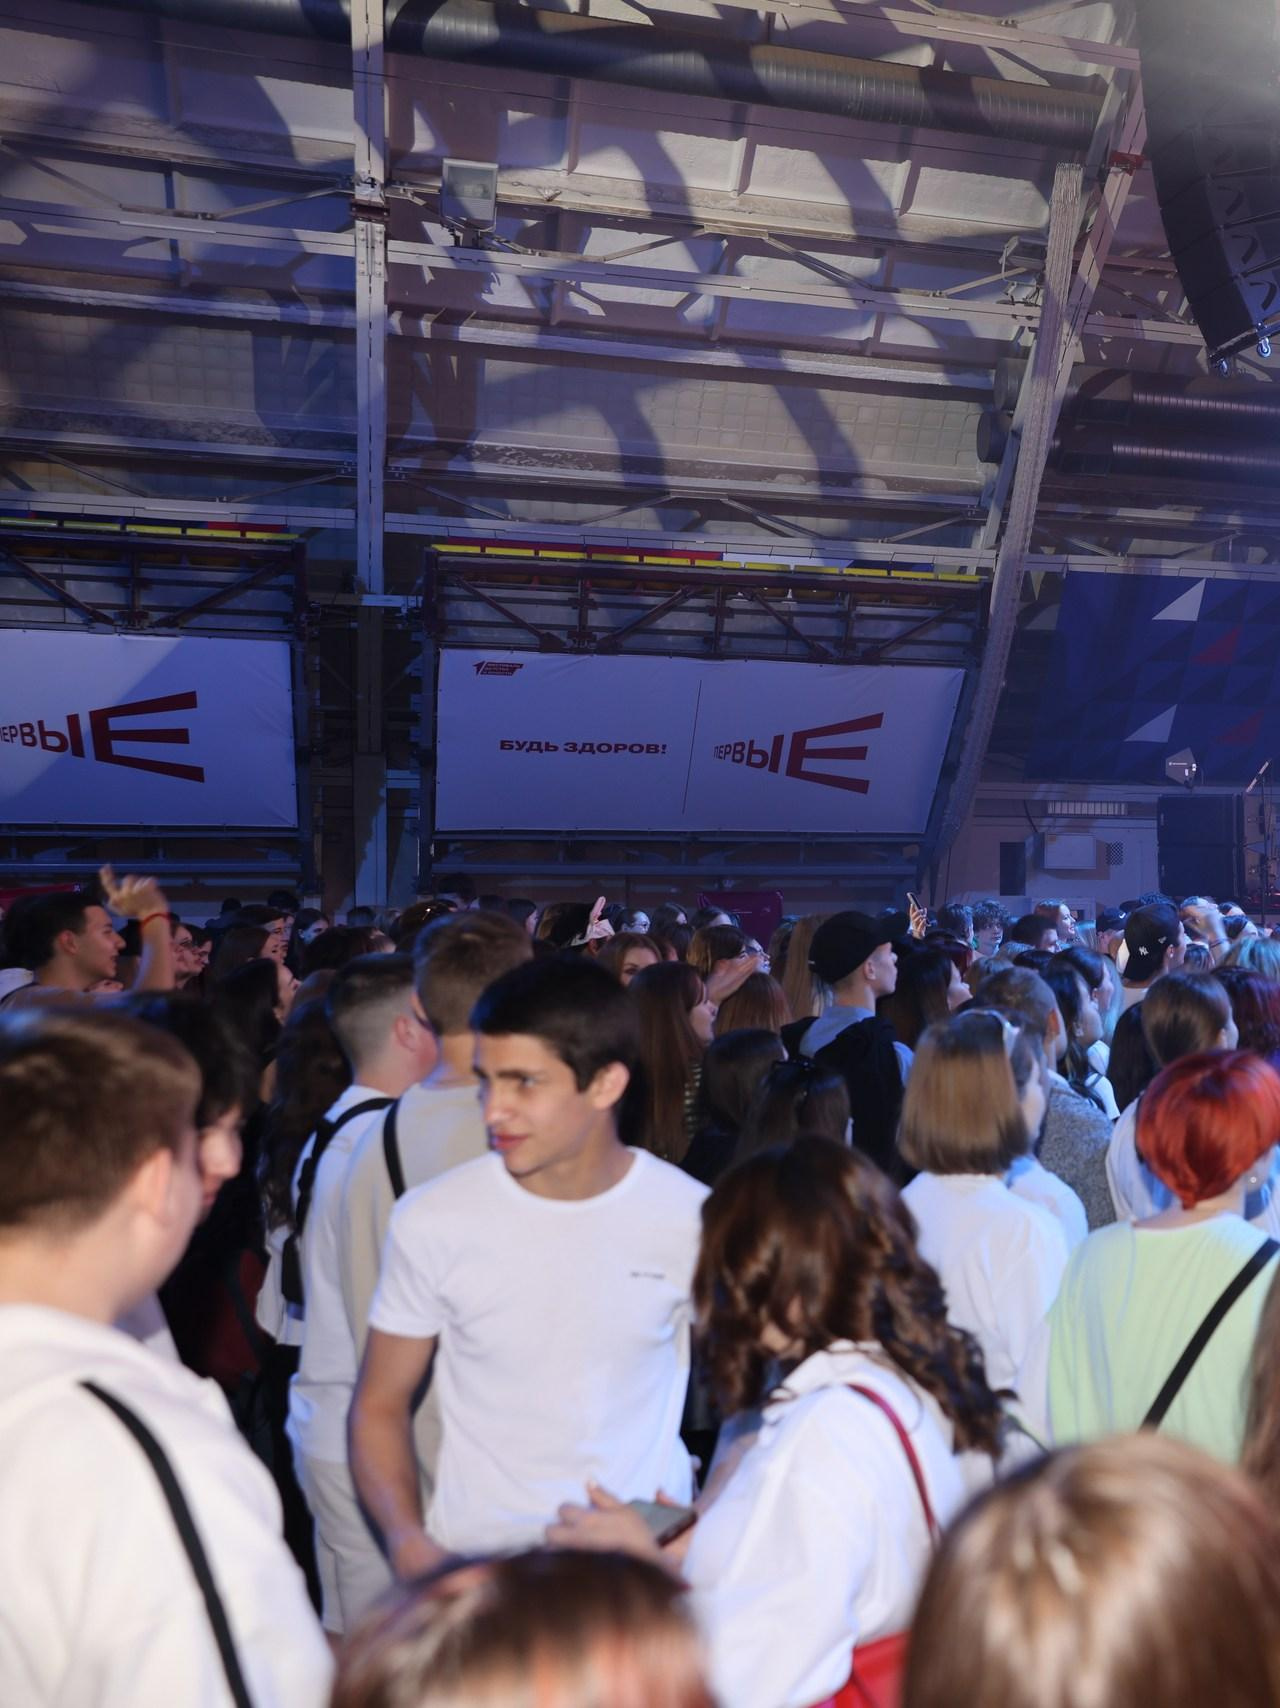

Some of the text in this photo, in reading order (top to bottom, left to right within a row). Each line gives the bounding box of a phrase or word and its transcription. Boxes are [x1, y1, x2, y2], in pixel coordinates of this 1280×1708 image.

[499, 739, 668, 755] БУДЬ ЗДОРОВ!
[713, 711, 885, 795] ПЕРВЫЕ
